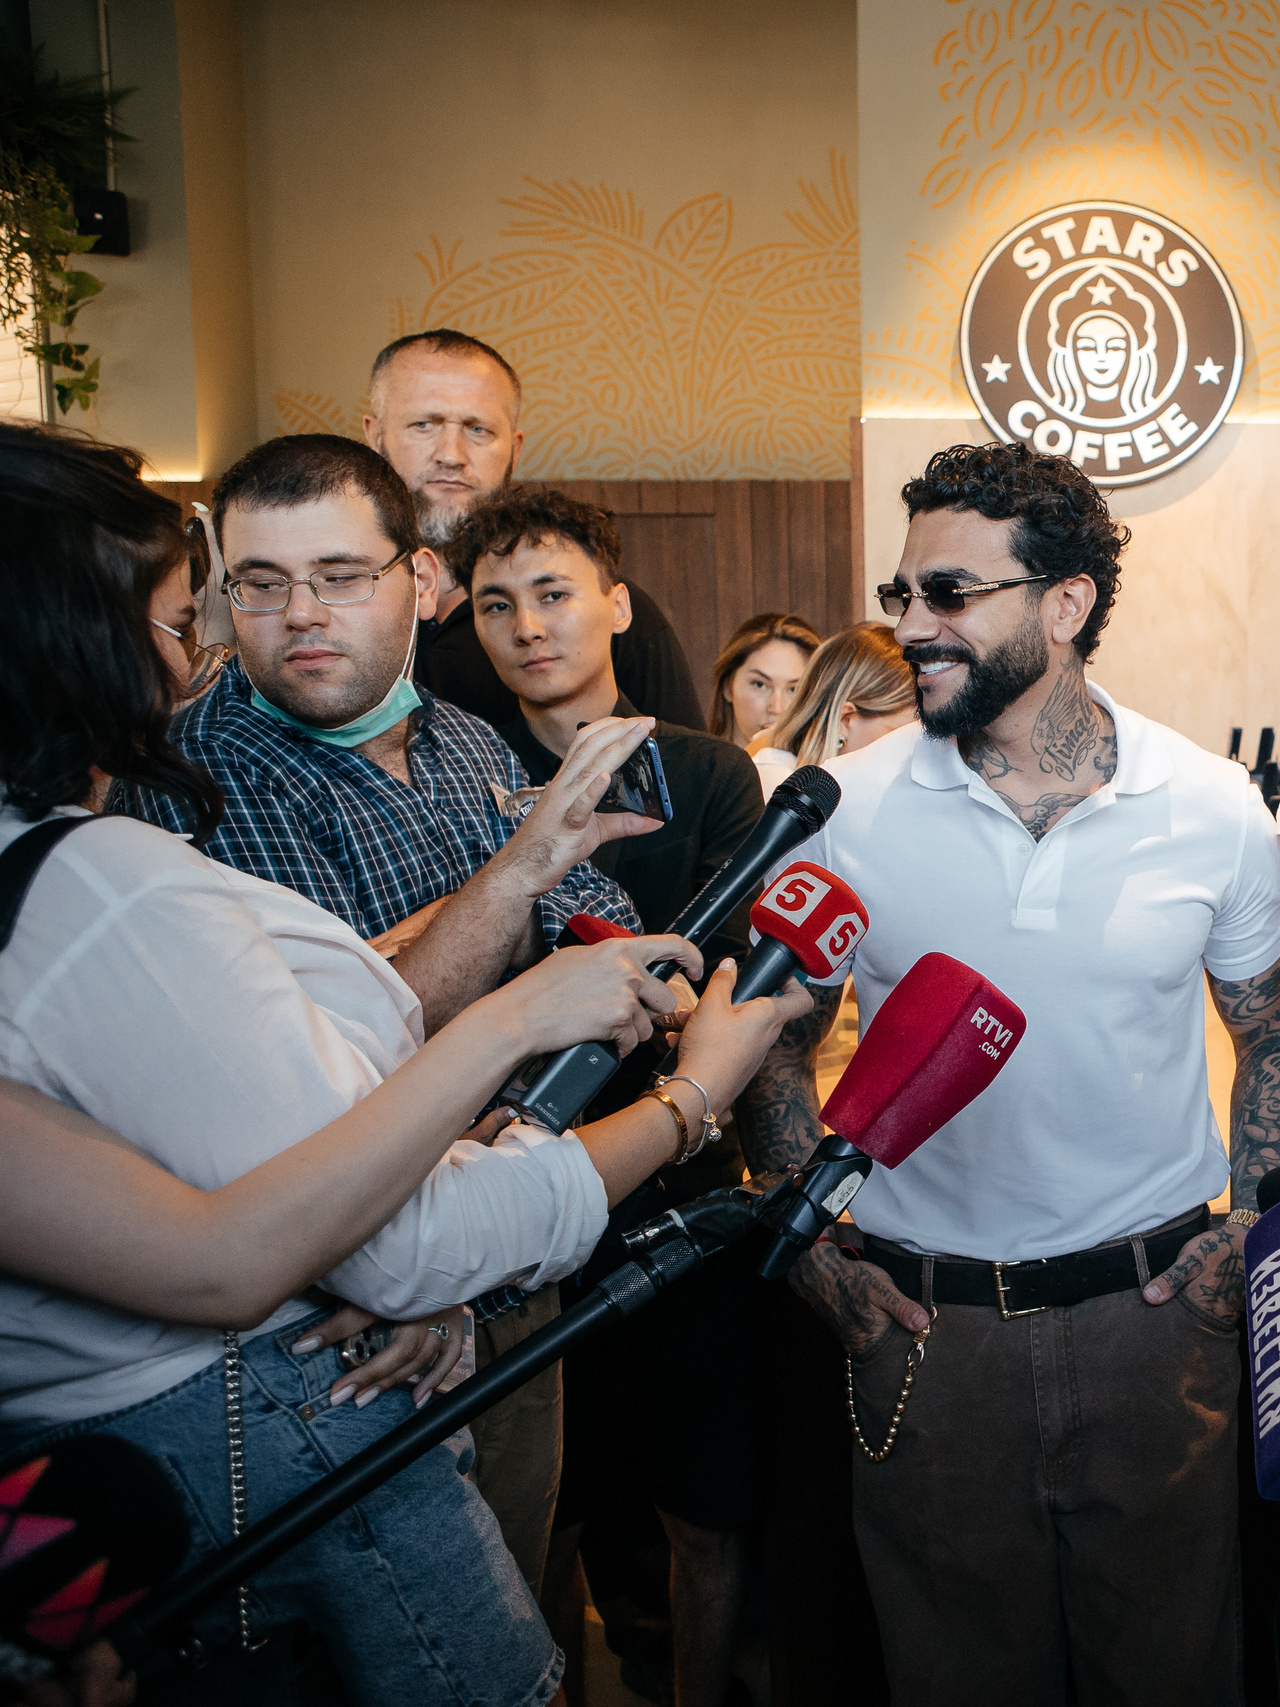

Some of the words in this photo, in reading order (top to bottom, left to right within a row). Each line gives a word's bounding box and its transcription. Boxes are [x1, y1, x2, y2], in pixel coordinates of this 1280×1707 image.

[1012, 216, 1200, 287] STARS
[1007, 399, 1199, 471] COFFEE
[775, 878, 816, 912] 5
[828, 920, 858, 957] 5
